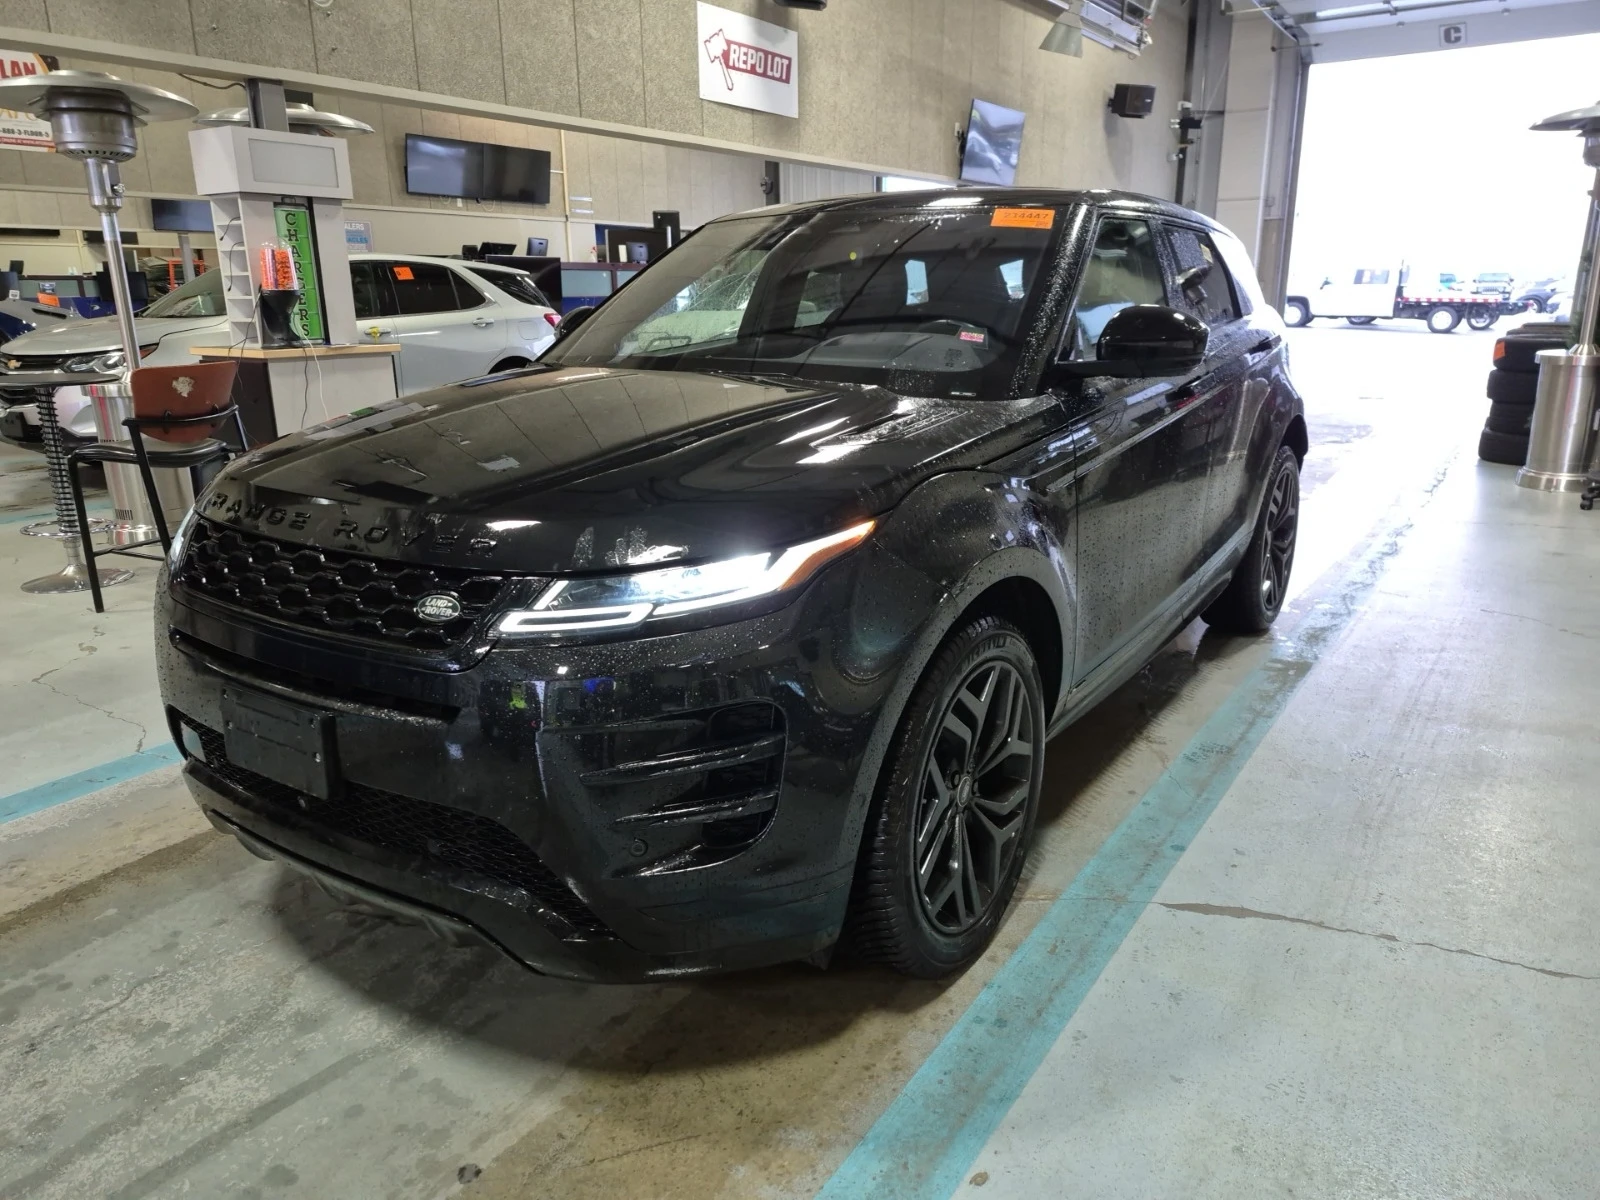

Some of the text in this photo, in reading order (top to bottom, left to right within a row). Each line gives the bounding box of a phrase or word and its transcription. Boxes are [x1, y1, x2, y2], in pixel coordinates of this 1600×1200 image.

[1444, 26, 1462, 44] C
[729, 44, 790, 80] REPO LOT
[210, 493, 498, 557] RANGE ROVER
[424, 606, 453, 616] ROVER
[425, 598, 448, 607] LAND
